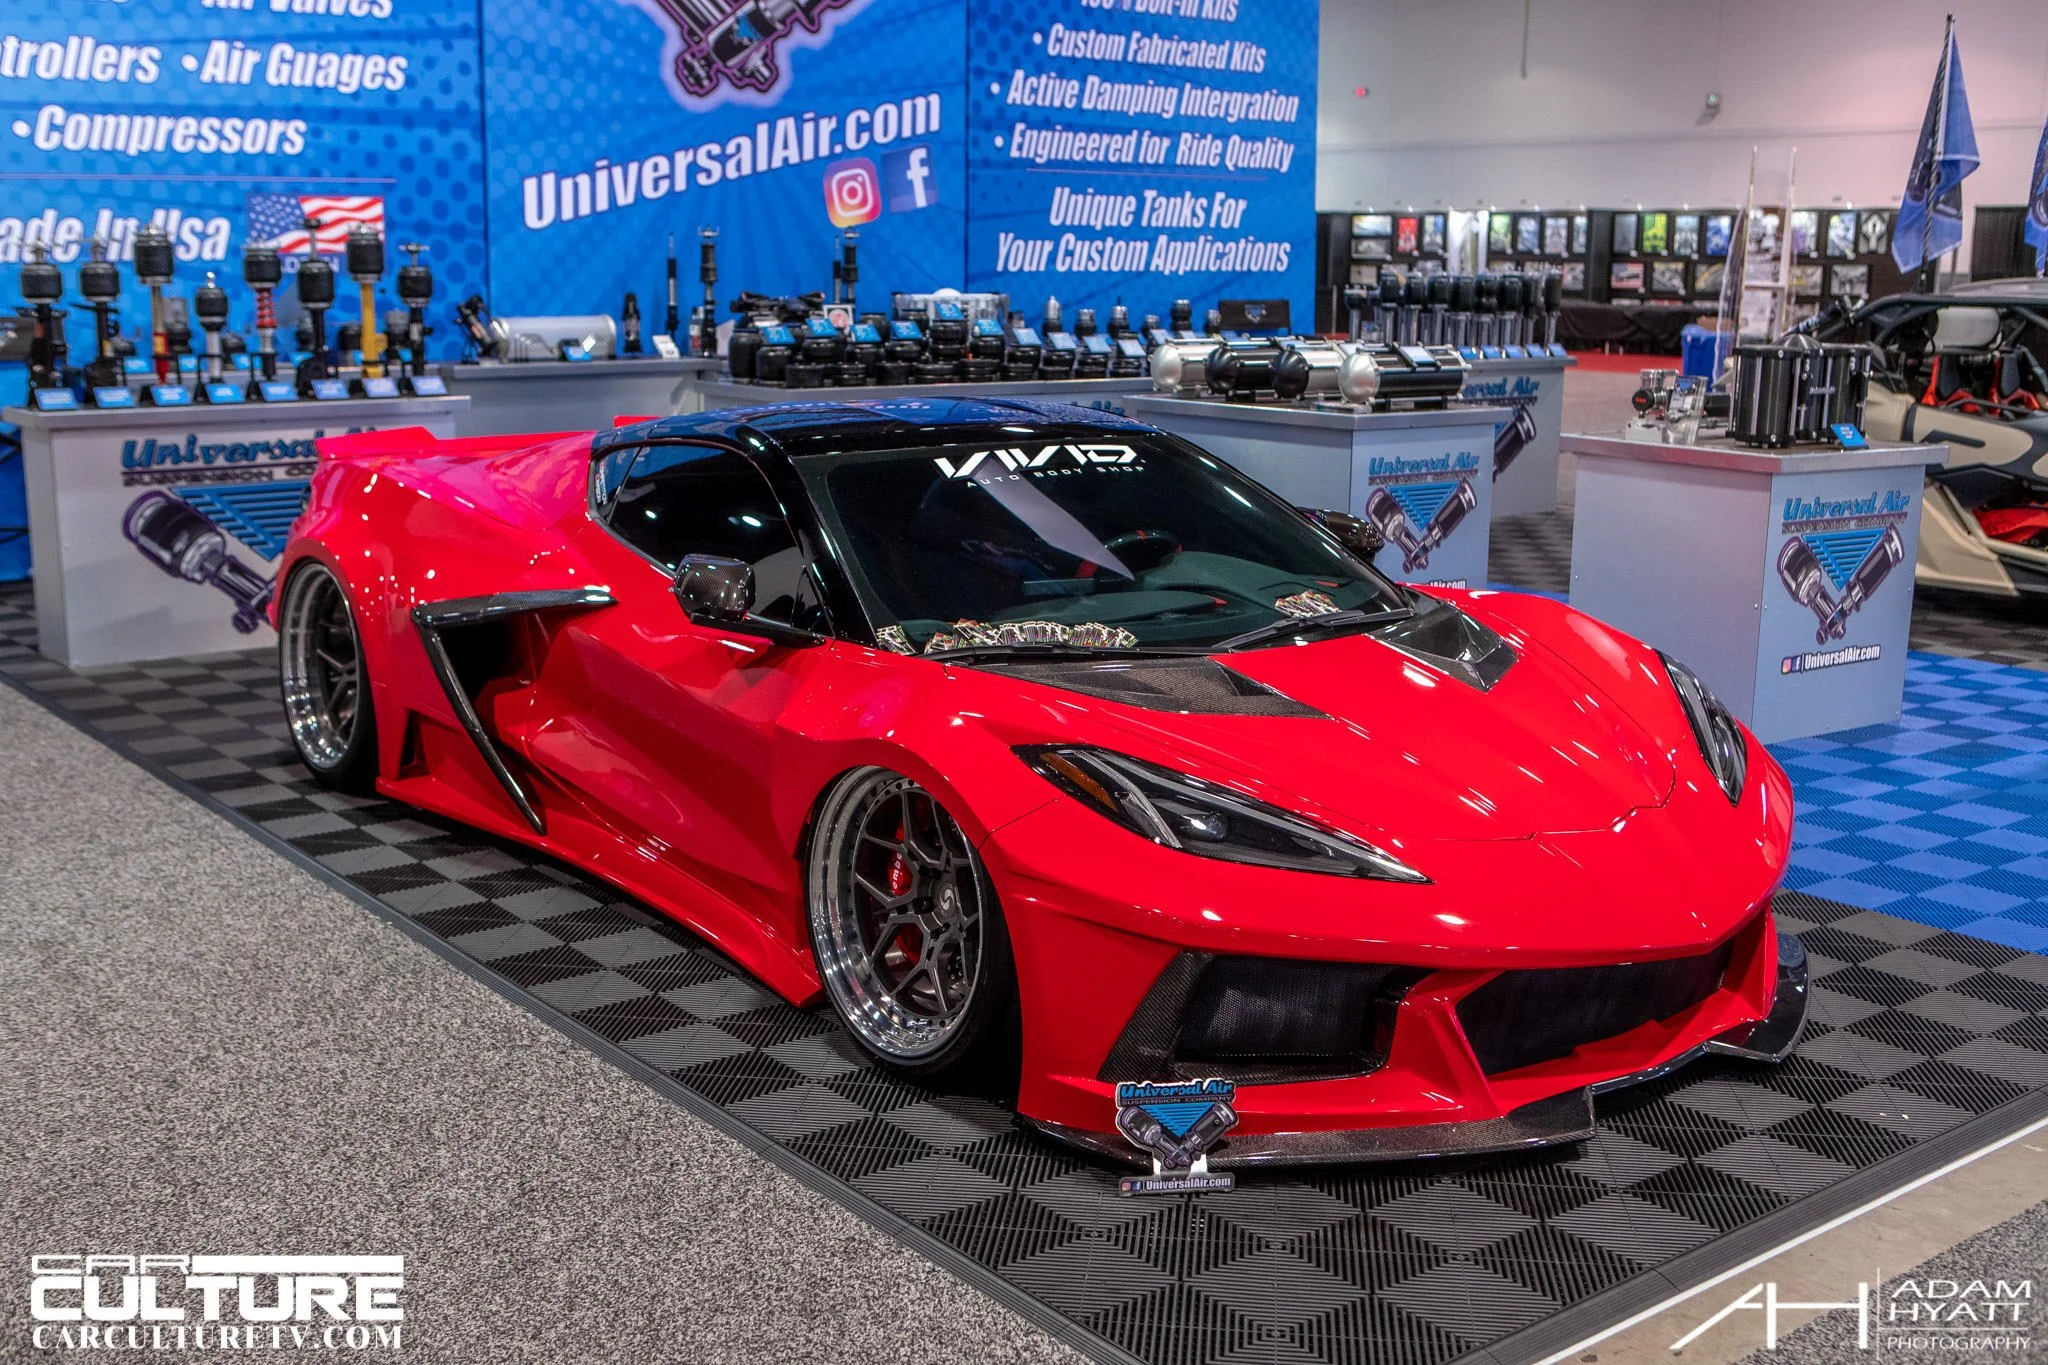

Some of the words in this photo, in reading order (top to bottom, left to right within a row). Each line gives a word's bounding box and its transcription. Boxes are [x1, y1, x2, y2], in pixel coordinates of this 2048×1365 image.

[200, 39, 262, 85] Air
[265, 42, 408, 94] Guages
[1047, 23, 1126, 62] Custom
[1127, 31, 1231, 70] Fabricated
[1230, 41, 1267, 74] Kits
[1007, 69, 1080, 110] Active
[1082, 74, 1179, 119] Damping
[1180, 82, 1300, 123] Intergration
[33, 104, 308, 156] Compressors
[1009, 122, 1138, 164] Engineered
[1139, 129, 1171, 165] for
[1175, 132, 1224, 167] Ride
[1225, 134, 1295, 173] Quality
[522, 92, 941, 230] UniversalAir.com
[1049, 186, 1137, 231] Unique
[1141, 189, 1207, 229] Tanks
[1209, 191, 1248, 229] For
[995, 232, 1054, 272] Your
[1055, 232, 1149, 272] Custom
[1150, 234, 1291, 276] Applications
[122, 430, 324, 469] Universal
[1452, 451, 1480, 470] Air
[967, 474, 1020, 488] AUTO
[1033, 468, 1083, 478] BODY
[1783, 491, 1877, 521] Universal
[1878, 490, 1911, 513] Air
[1121, 1080, 1202, 1098] Universal
[1205, 1081, 1232, 1094] Air
[1146, 1177, 1231, 1191] UniversalAir.com
